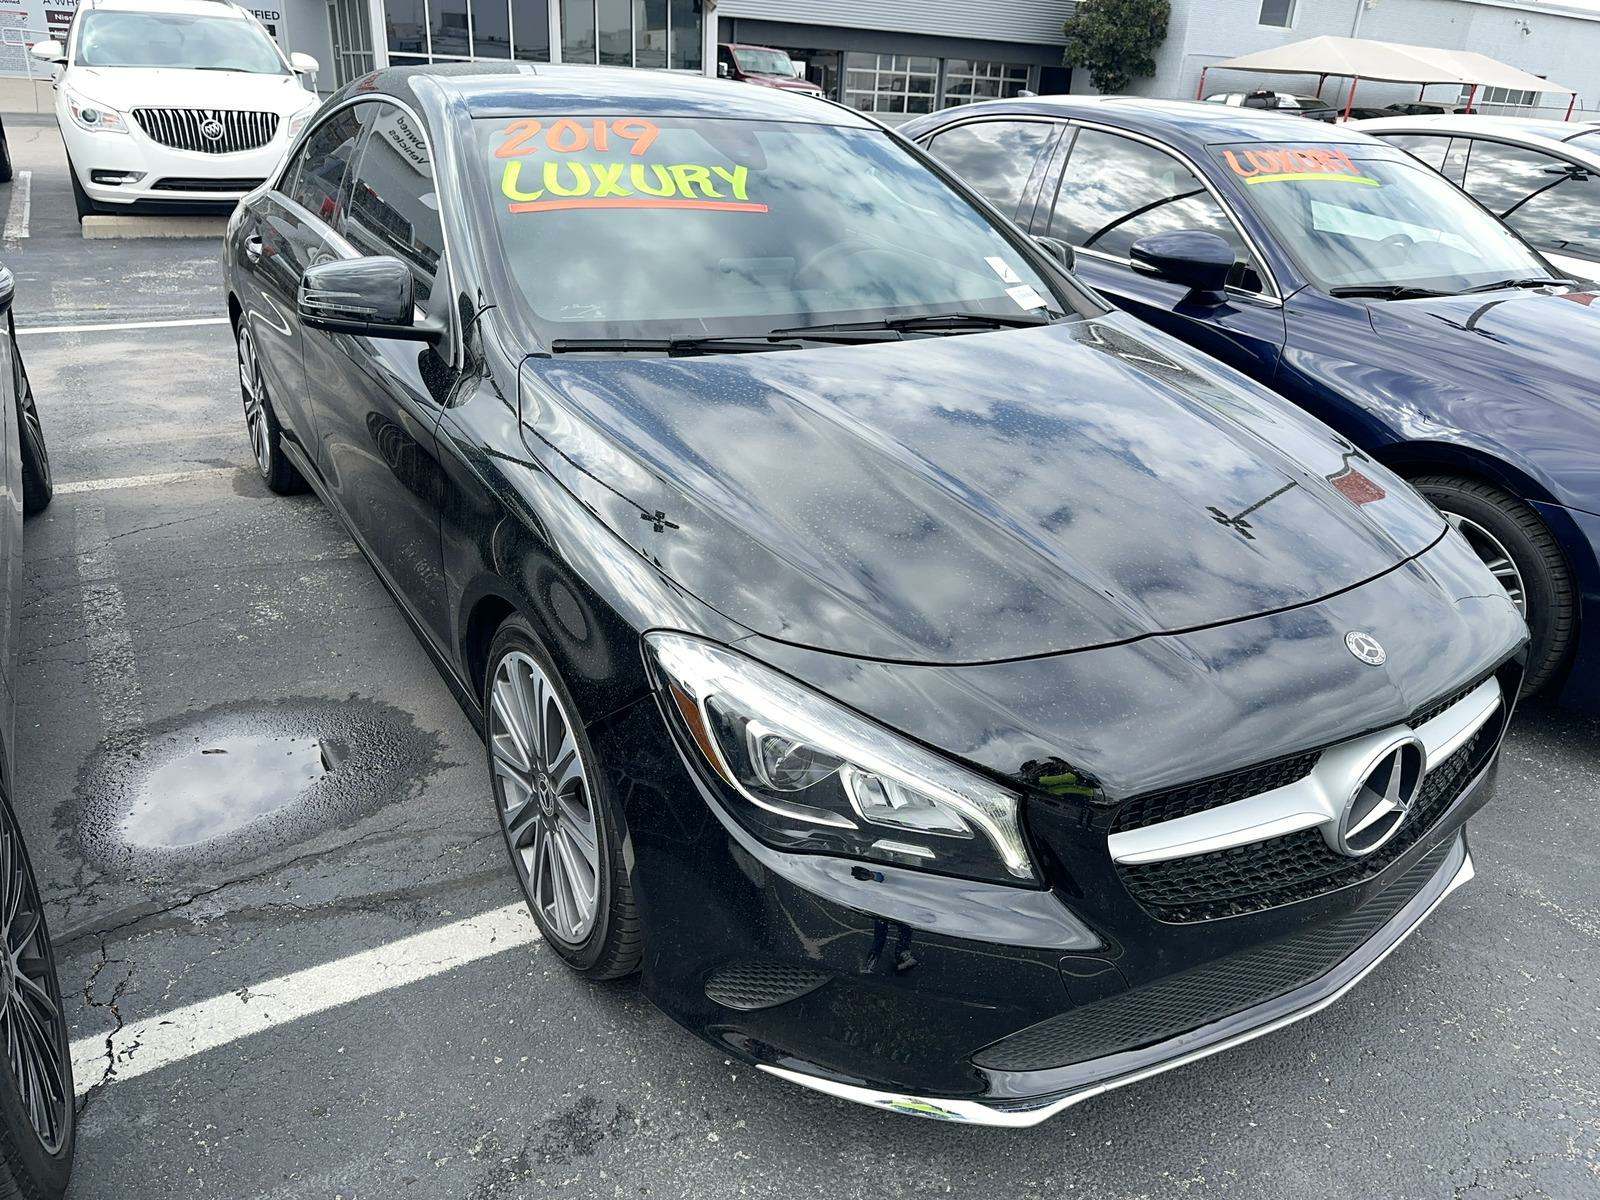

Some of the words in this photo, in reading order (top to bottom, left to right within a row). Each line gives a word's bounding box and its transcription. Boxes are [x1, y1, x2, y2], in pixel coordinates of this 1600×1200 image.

[495, 119, 660, 158] 2019
[501, 160, 749, 202] LUXURY
[1222, 149, 1361, 177] LUXURY
